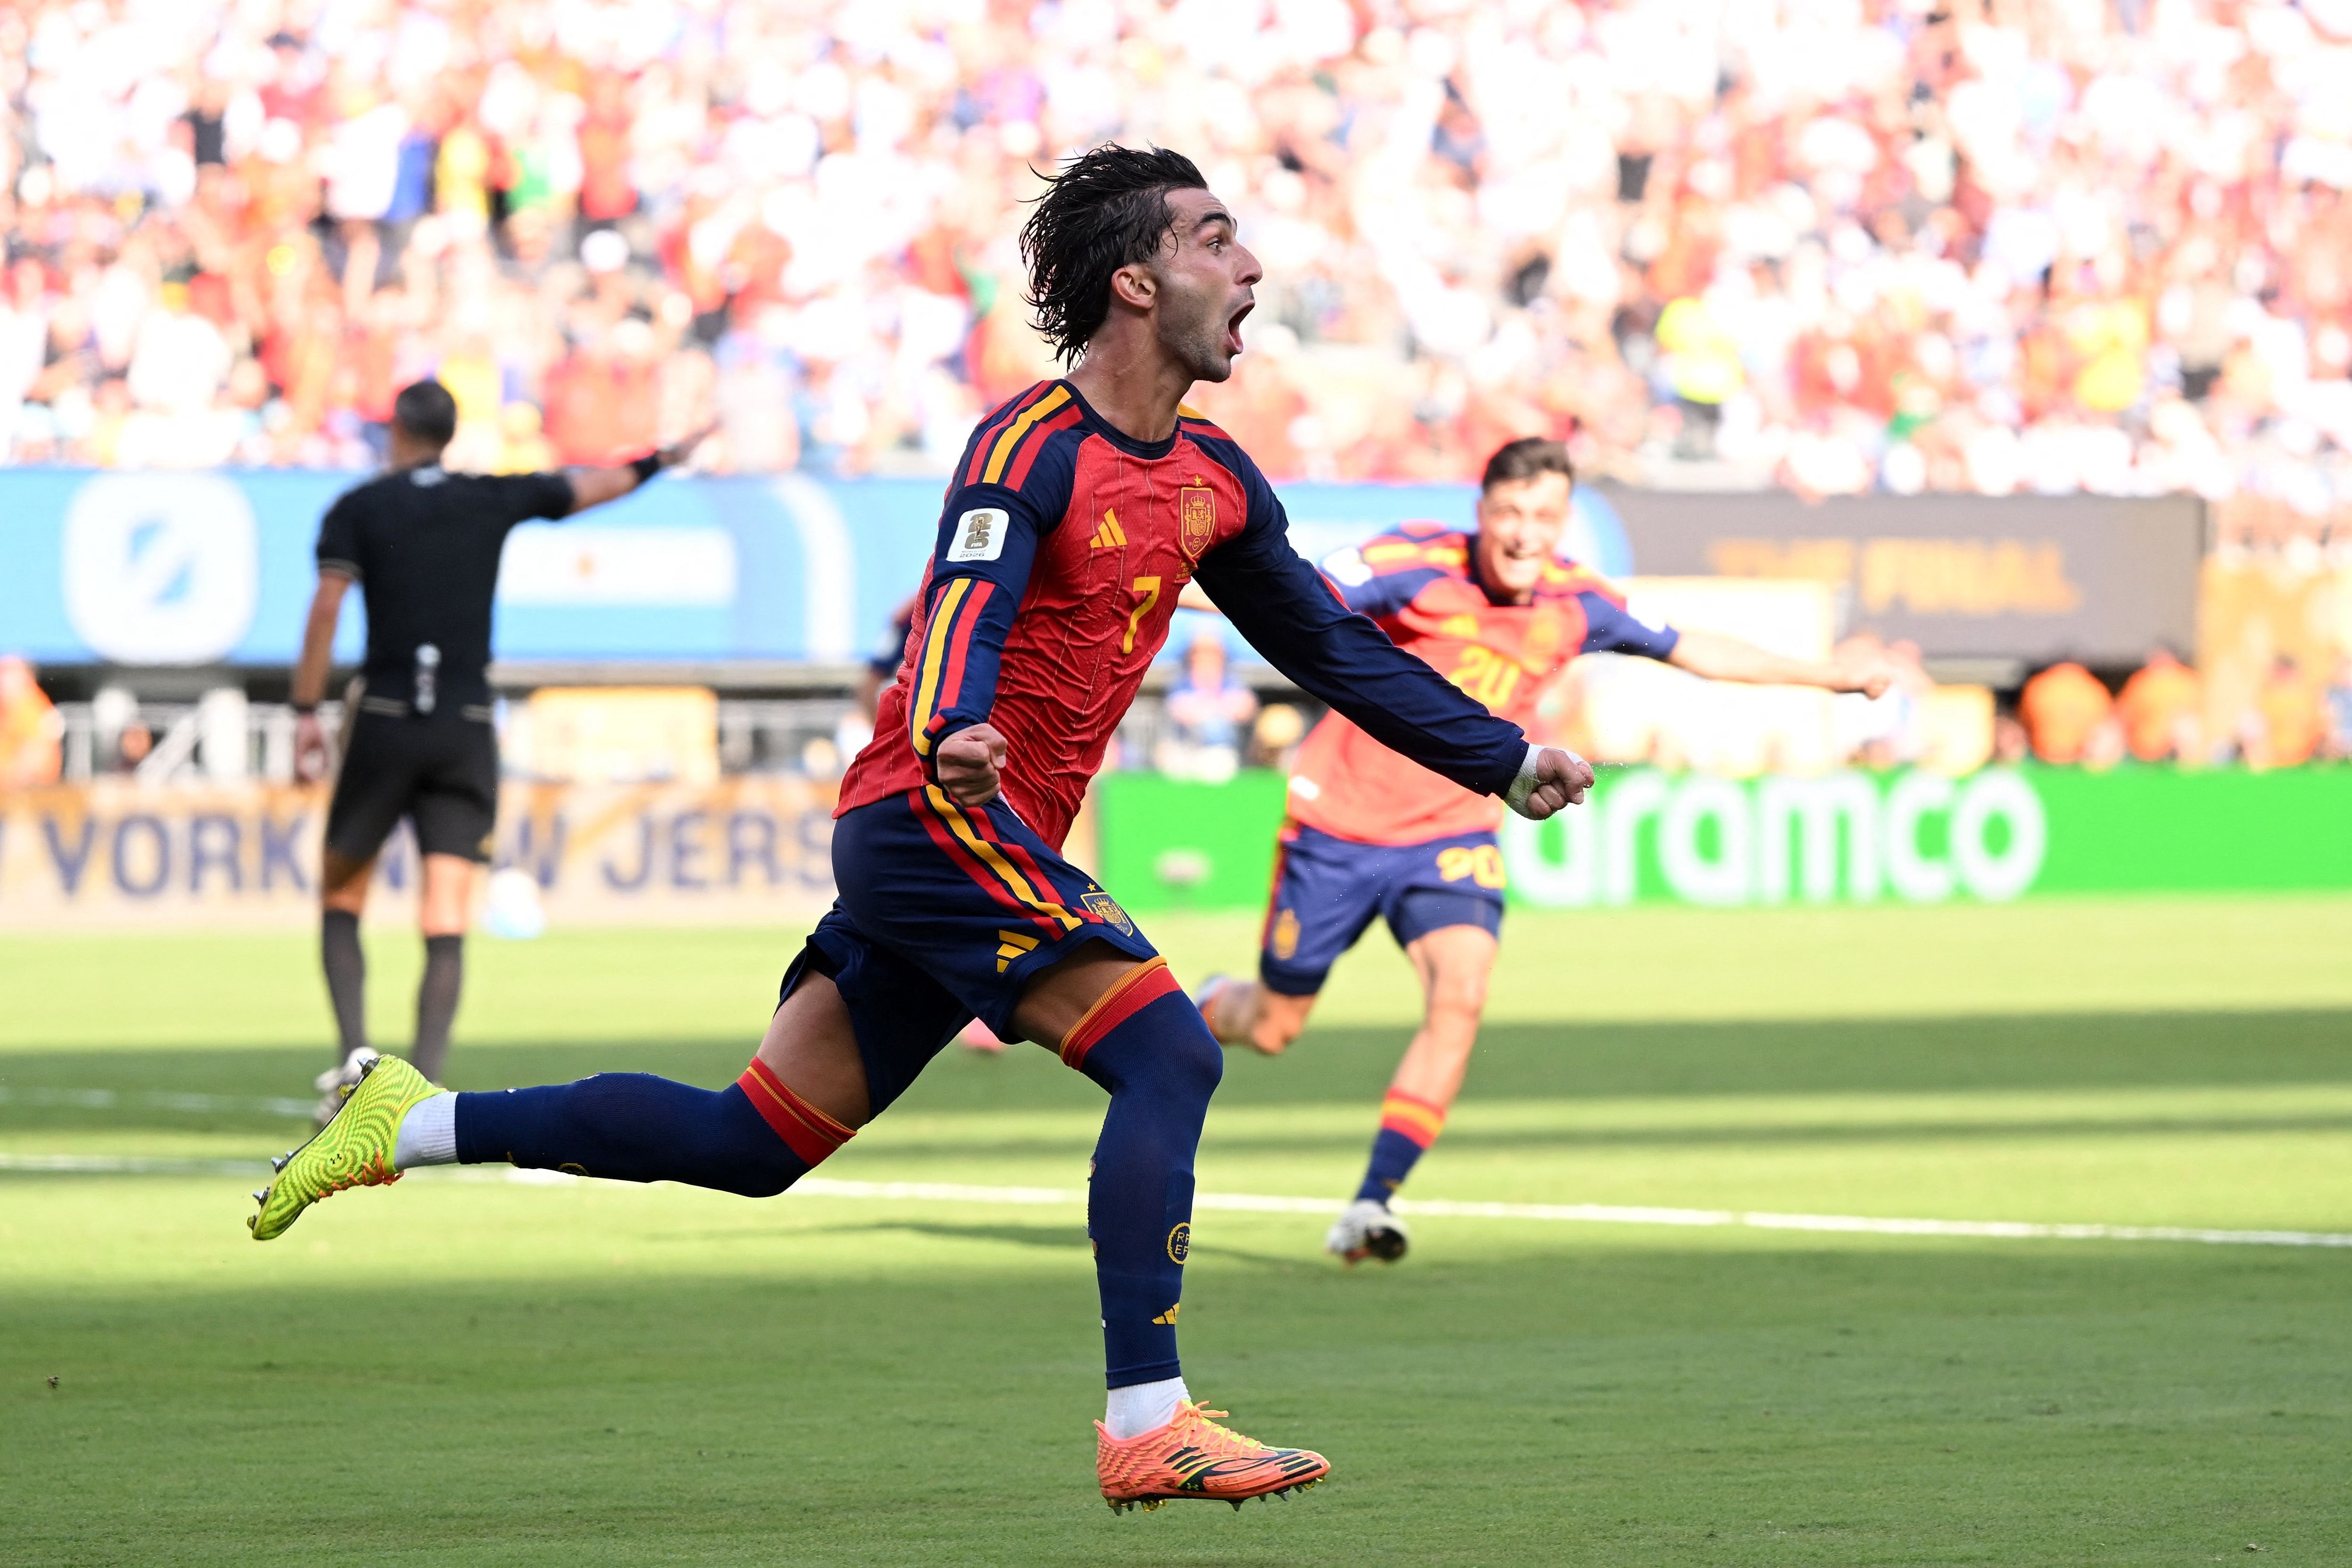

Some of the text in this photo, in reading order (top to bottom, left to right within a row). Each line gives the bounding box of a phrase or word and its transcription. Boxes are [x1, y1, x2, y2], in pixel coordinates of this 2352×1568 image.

[1122, 576, 1161, 654] 7
[1447, 645, 1521, 707] 20
[1507, 769, 2045, 903] aramco
